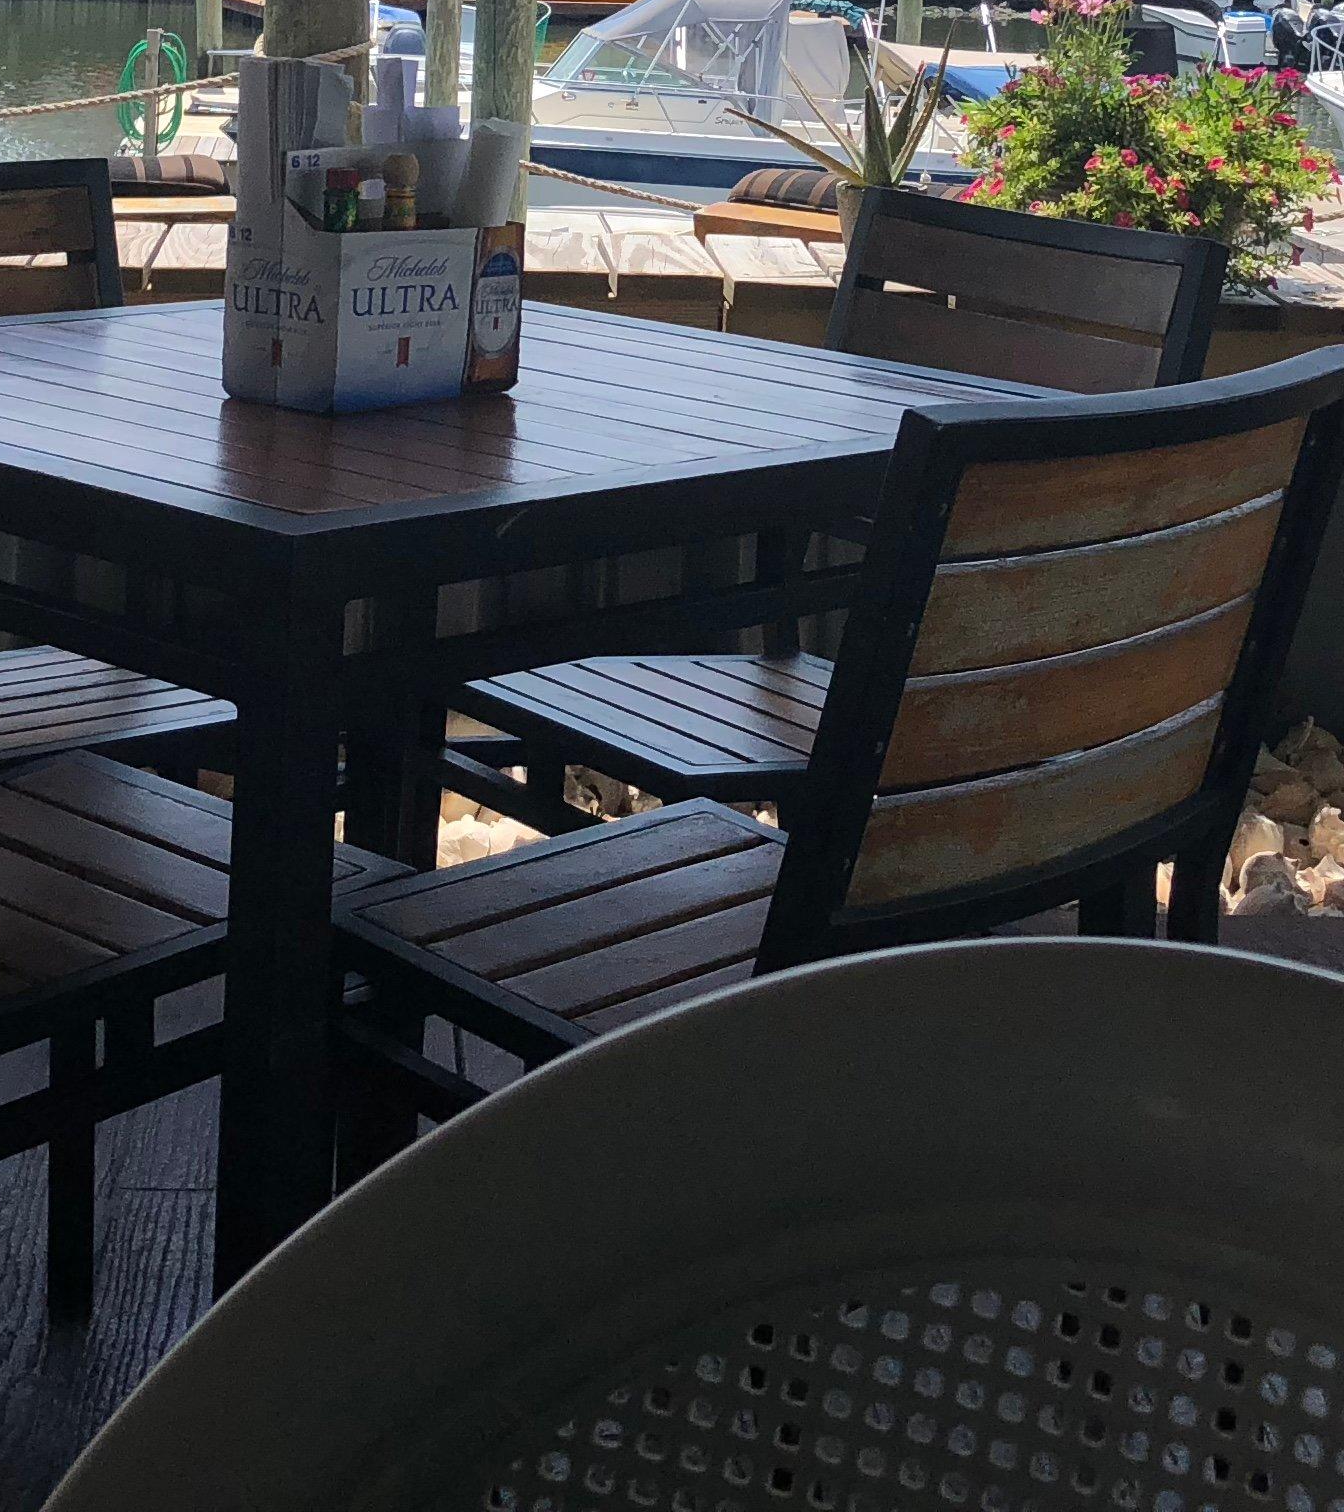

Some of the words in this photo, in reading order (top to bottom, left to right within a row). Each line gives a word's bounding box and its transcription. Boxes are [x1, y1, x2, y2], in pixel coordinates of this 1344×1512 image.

[291, 155, 301, 169] 6
[306, 153, 320, 167] 12
[241, 228, 253, 242] 12
[367, 255, 450, 282] Michelob
[233, 283, 325, 324] ULTRA
[351, 283, 459, 317] ULTRA
[475, 296, 519, 315] ULTRA
